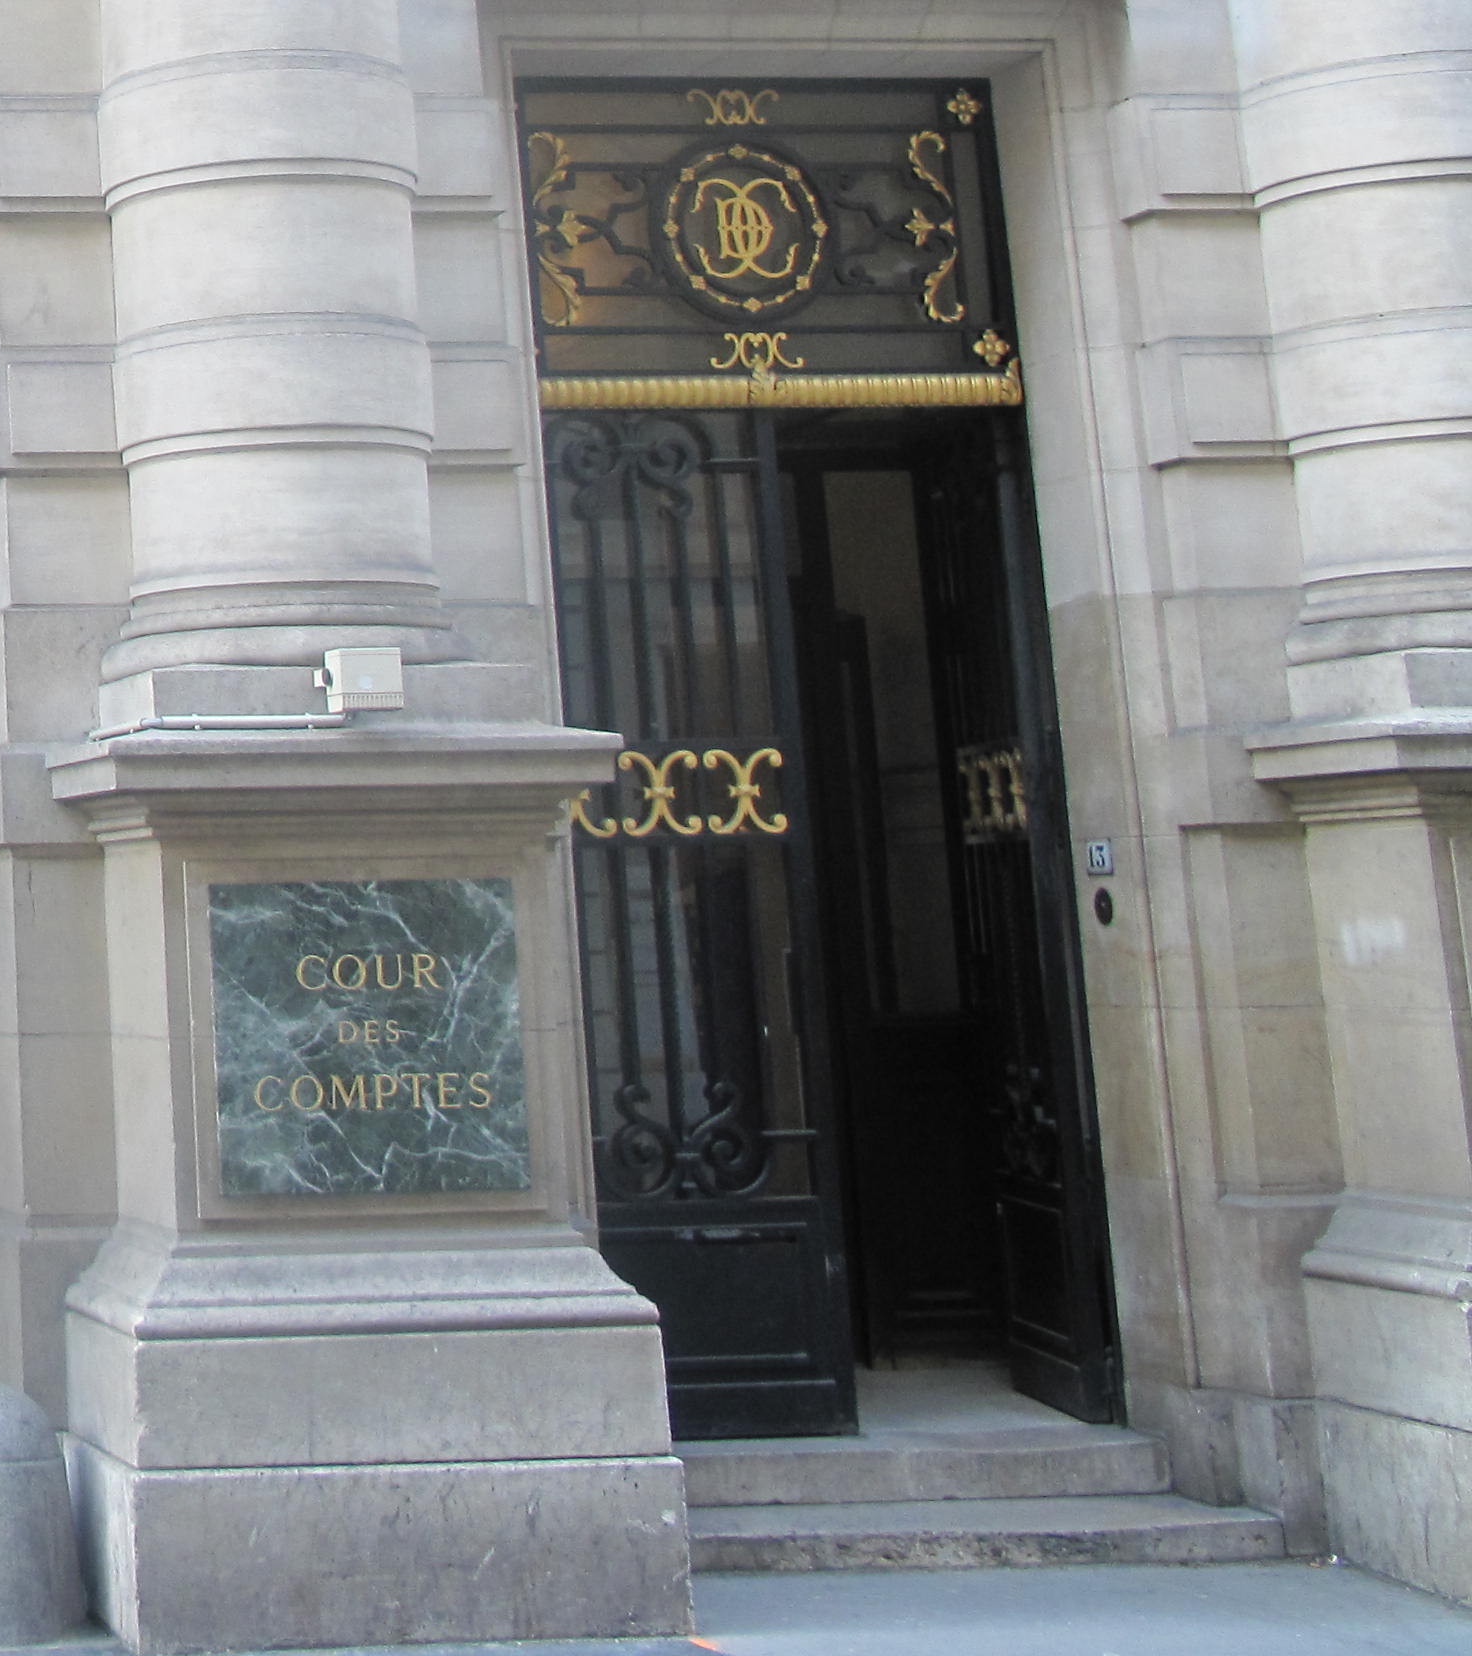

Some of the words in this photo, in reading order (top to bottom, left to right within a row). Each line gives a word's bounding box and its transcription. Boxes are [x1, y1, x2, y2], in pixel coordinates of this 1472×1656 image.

[1089, 845, 1106, 868] 13
[296, 953, 444, 990] COUR
[338, 1019, 401, 1044] DES
[255, 1071, 493, 1111] COMPTES
